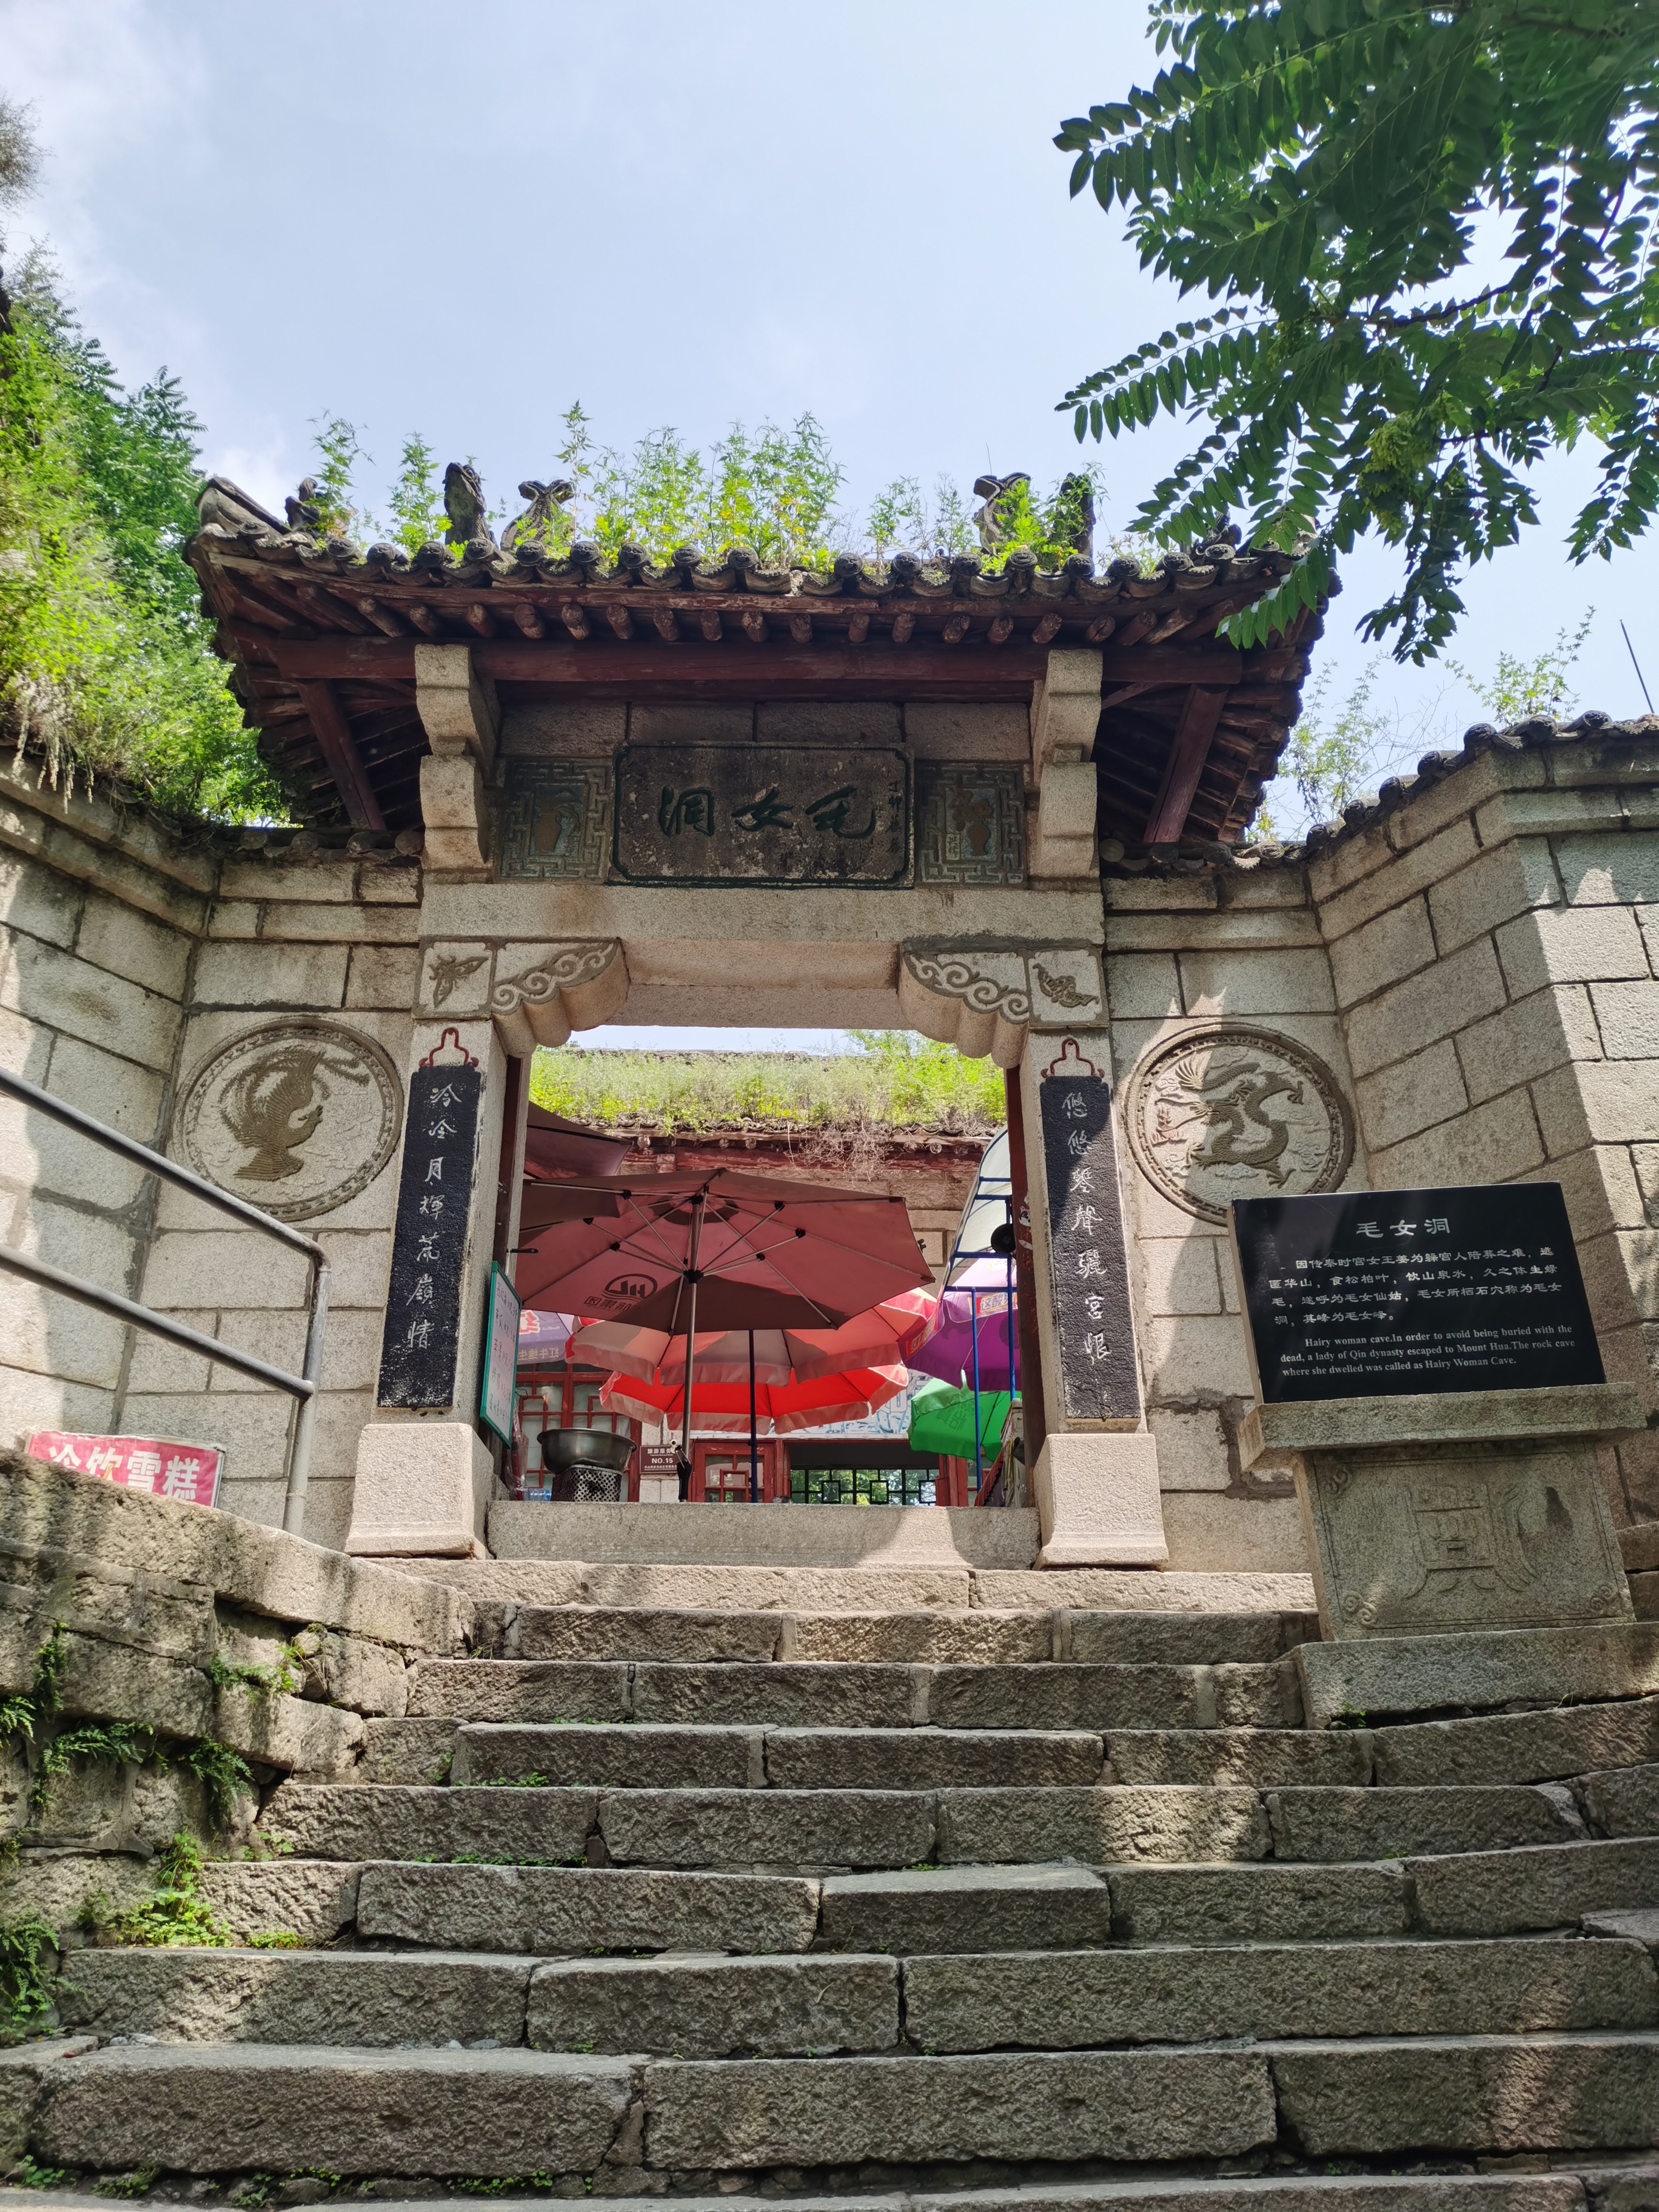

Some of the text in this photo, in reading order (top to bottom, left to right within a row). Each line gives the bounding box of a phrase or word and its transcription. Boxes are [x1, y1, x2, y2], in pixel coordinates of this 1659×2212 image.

[659, 785, 876, 839] 毛女洞
[1356, 1218, 1450, 1238] 毛女洞
[1305, 1338, 1331, 1348] Hairy
[1334, 1336, 1367, 1345] woman
[1406, 1333, 1430, 1342] order
[1433, 1332, 1443, 1340] to
[1446, 1330, 1470, 1339] avoid
[1473, 1329, 1500, 1339] being
[1501, 1326, 1532, 1336] buried
[1534, 1326, 1555, 1334] with
[1557, 1324, 1573, 1333] the
[1280, 1353, 1305, 1362] dead,
[1315, 1352, 1335, 1362] lady
[1338, 1350, 1347, 1359] of
[1349, 1350, 1367, 1360] Qin
[1369, 1349, 1404, 1359] dynasty
[1407, 1346, 1442, 1356] escaped
[1444, 1344, 1454, 1353] to
[1456, 1343, 1487, 1353] Mount
[1532, 1339, 1553, 1349] rock
[1282, 1367, 1313, 1376] where
[1312, 1366, 1327, 1375] she
[1329, 1364, 1363, 1374] dwelled
[1385, 1361, 1412, 1371] called
[1425, 1359, 1451, 1370] Hairy
[1453, 1358, 1489, 1367] Woman
[1490, 1356, 1517, 1365] Cave.
